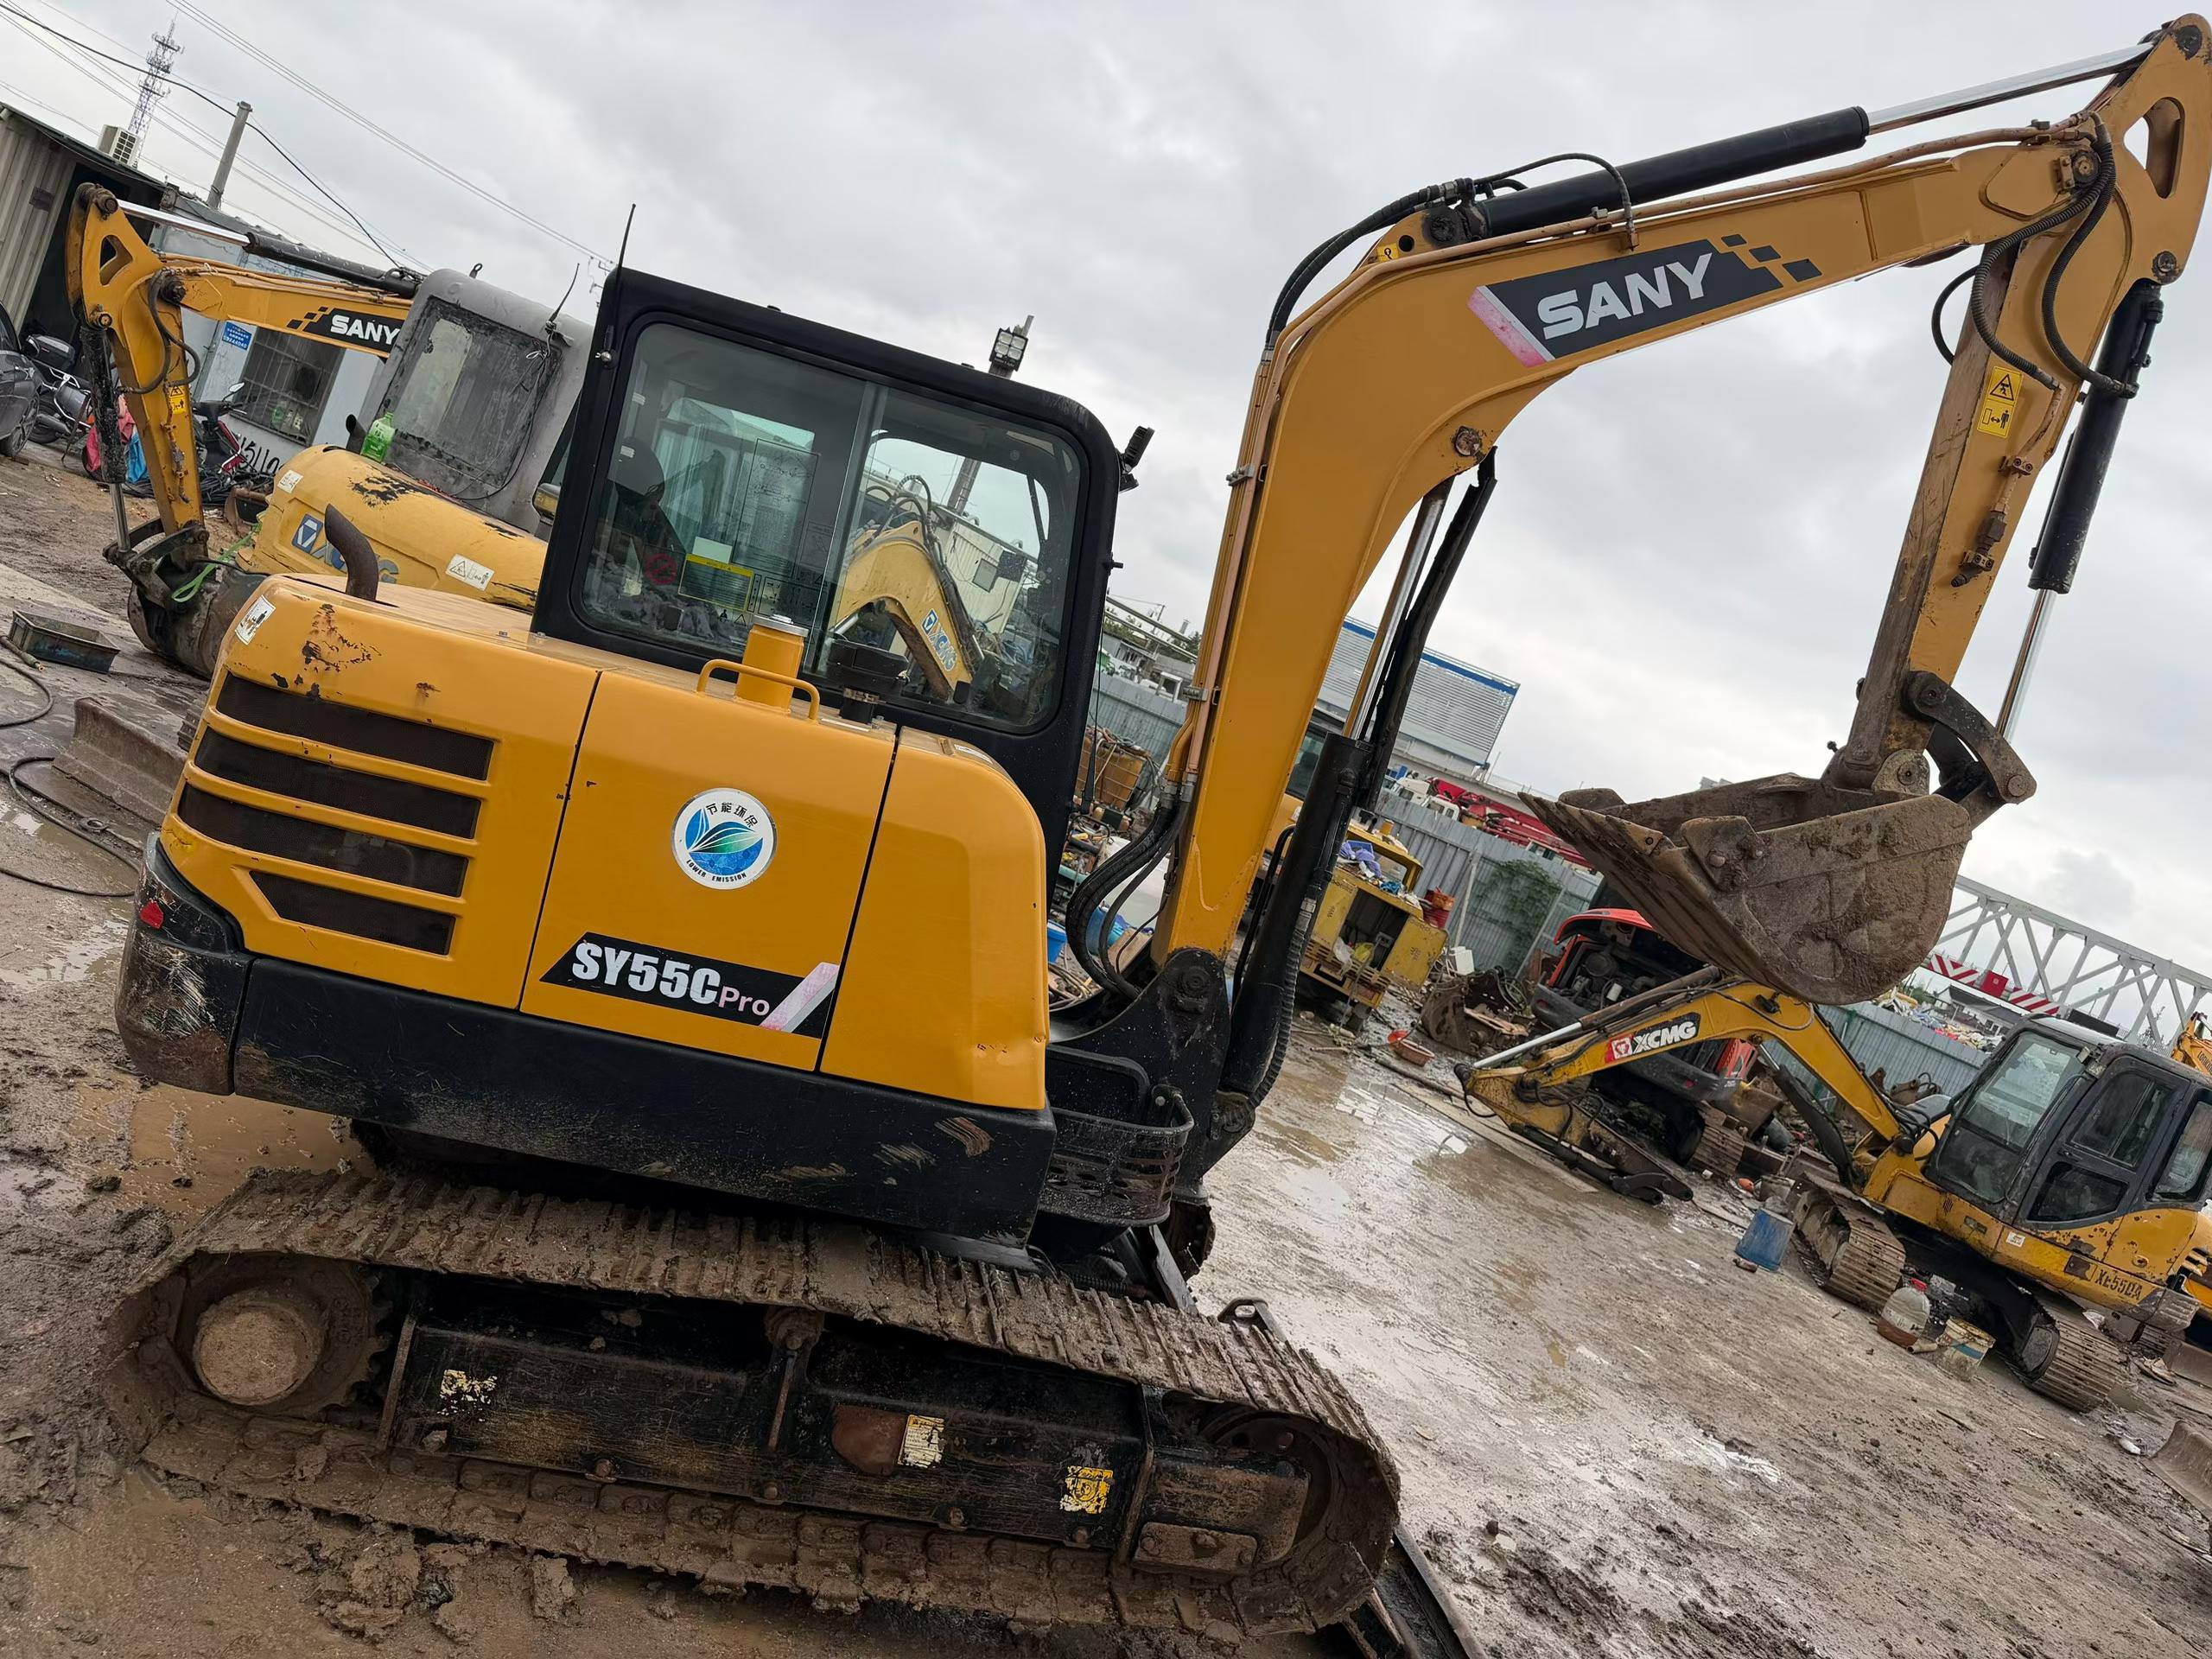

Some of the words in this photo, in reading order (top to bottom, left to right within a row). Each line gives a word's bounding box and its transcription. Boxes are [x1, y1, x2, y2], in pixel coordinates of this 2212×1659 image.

[1537, 252, 1713, 340] SANY
[330, 314, 400, 345] SANY
[706, 802, 759, 828] 节能环保
[686, 859, 707, 878] LOWER
[711, 872, 747, 883] EMISSION
[572, 942, 721, 1005] SY55C
[1632, 1021, 1697, 1055] XCMG
